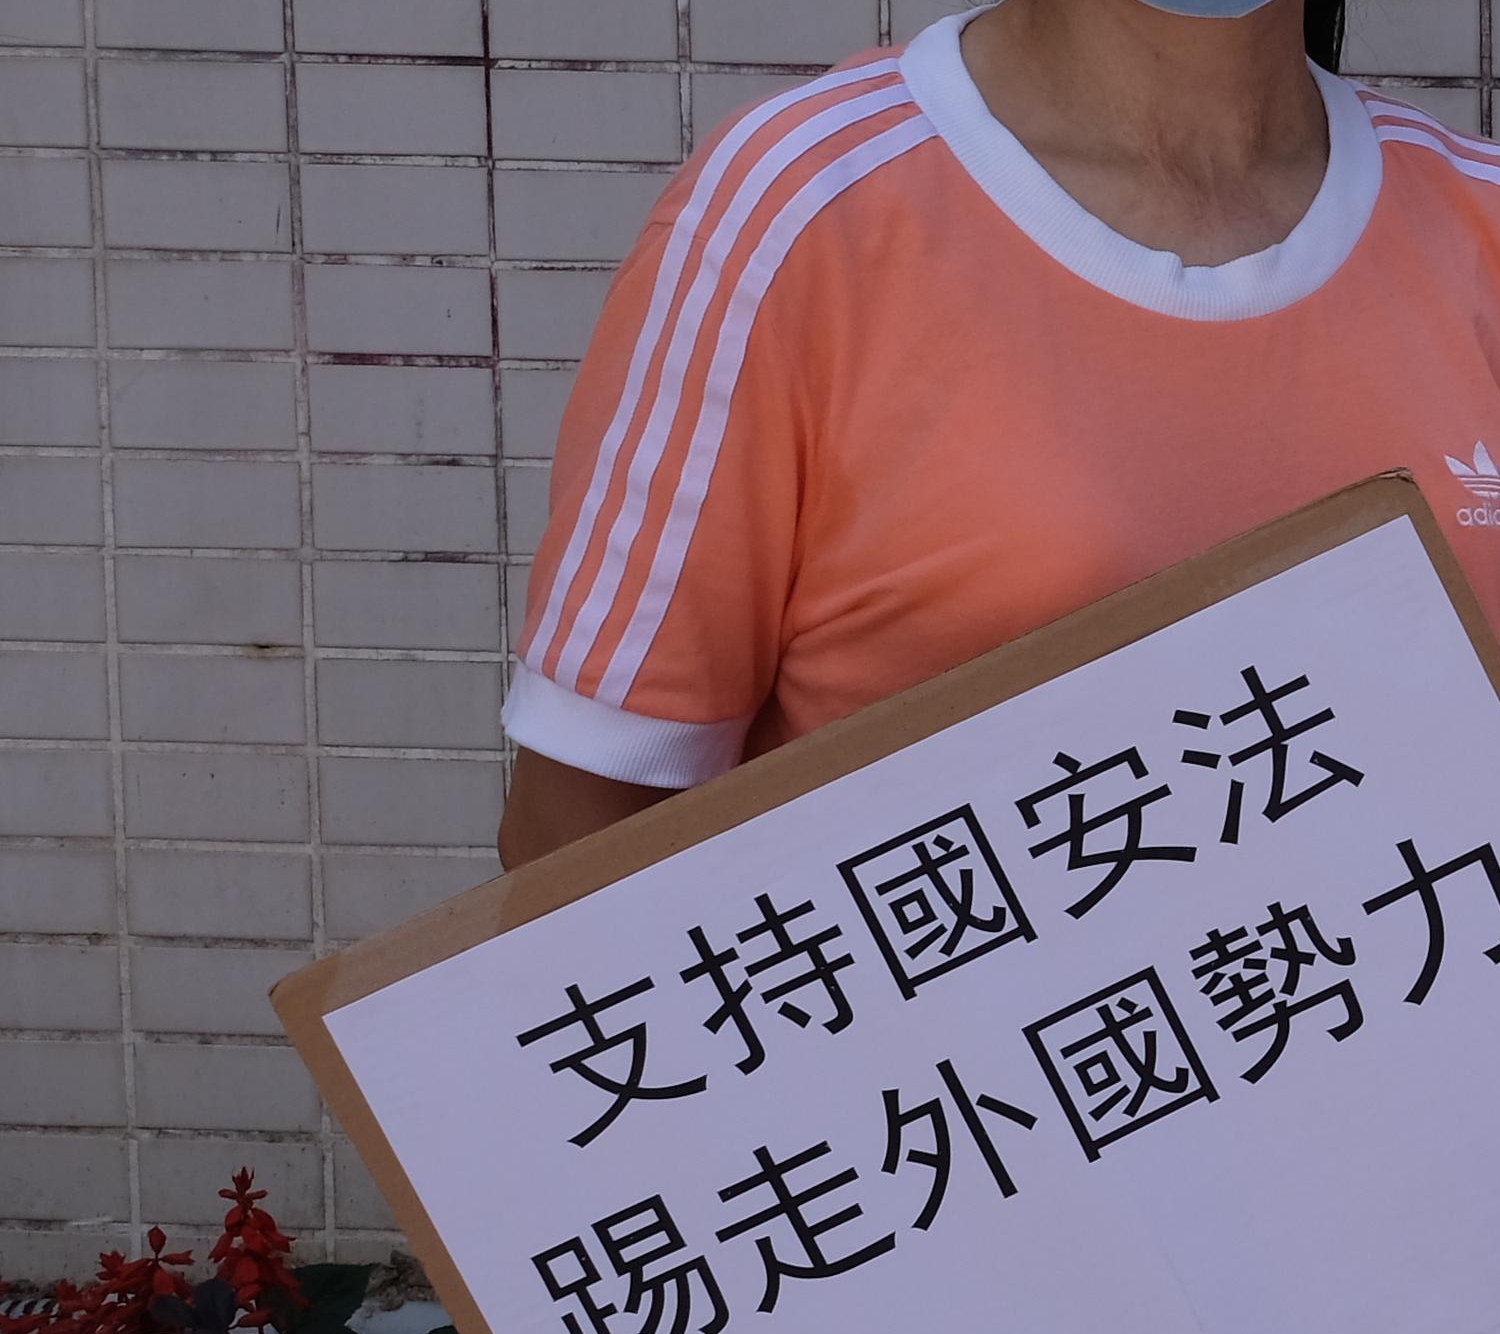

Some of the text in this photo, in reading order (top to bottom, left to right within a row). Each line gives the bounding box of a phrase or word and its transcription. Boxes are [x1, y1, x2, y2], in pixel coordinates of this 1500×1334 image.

[517, 666, 1364, 1147] 支持國安法
